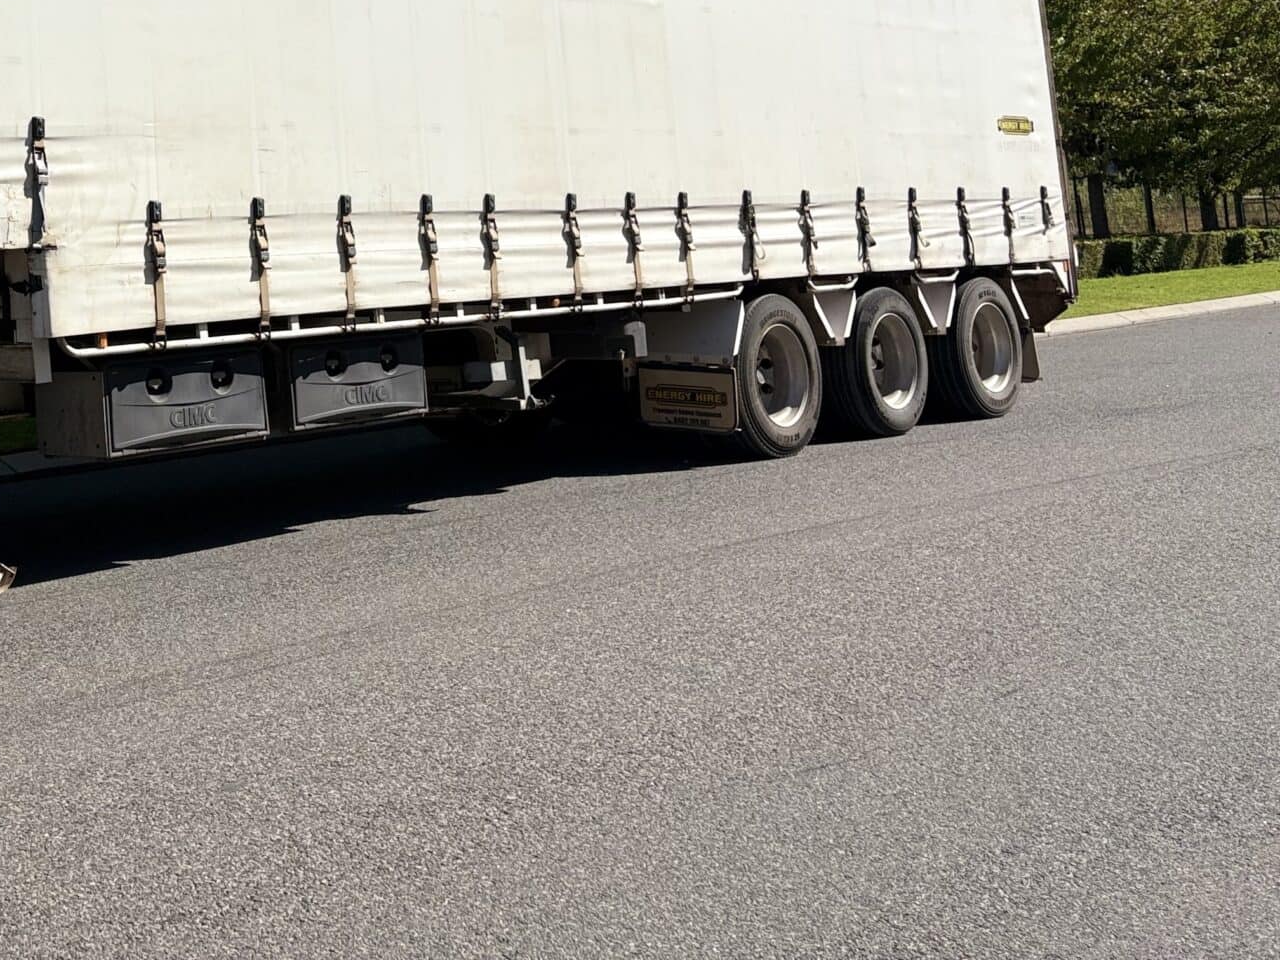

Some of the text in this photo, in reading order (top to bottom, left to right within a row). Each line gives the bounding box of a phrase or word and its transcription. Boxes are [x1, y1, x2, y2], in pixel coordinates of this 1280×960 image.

[344, 385, 389, 406] CIMC
[648, 390, 723, 405] ENERGY HIRE
[170, 403, 217, 429] CIMC
